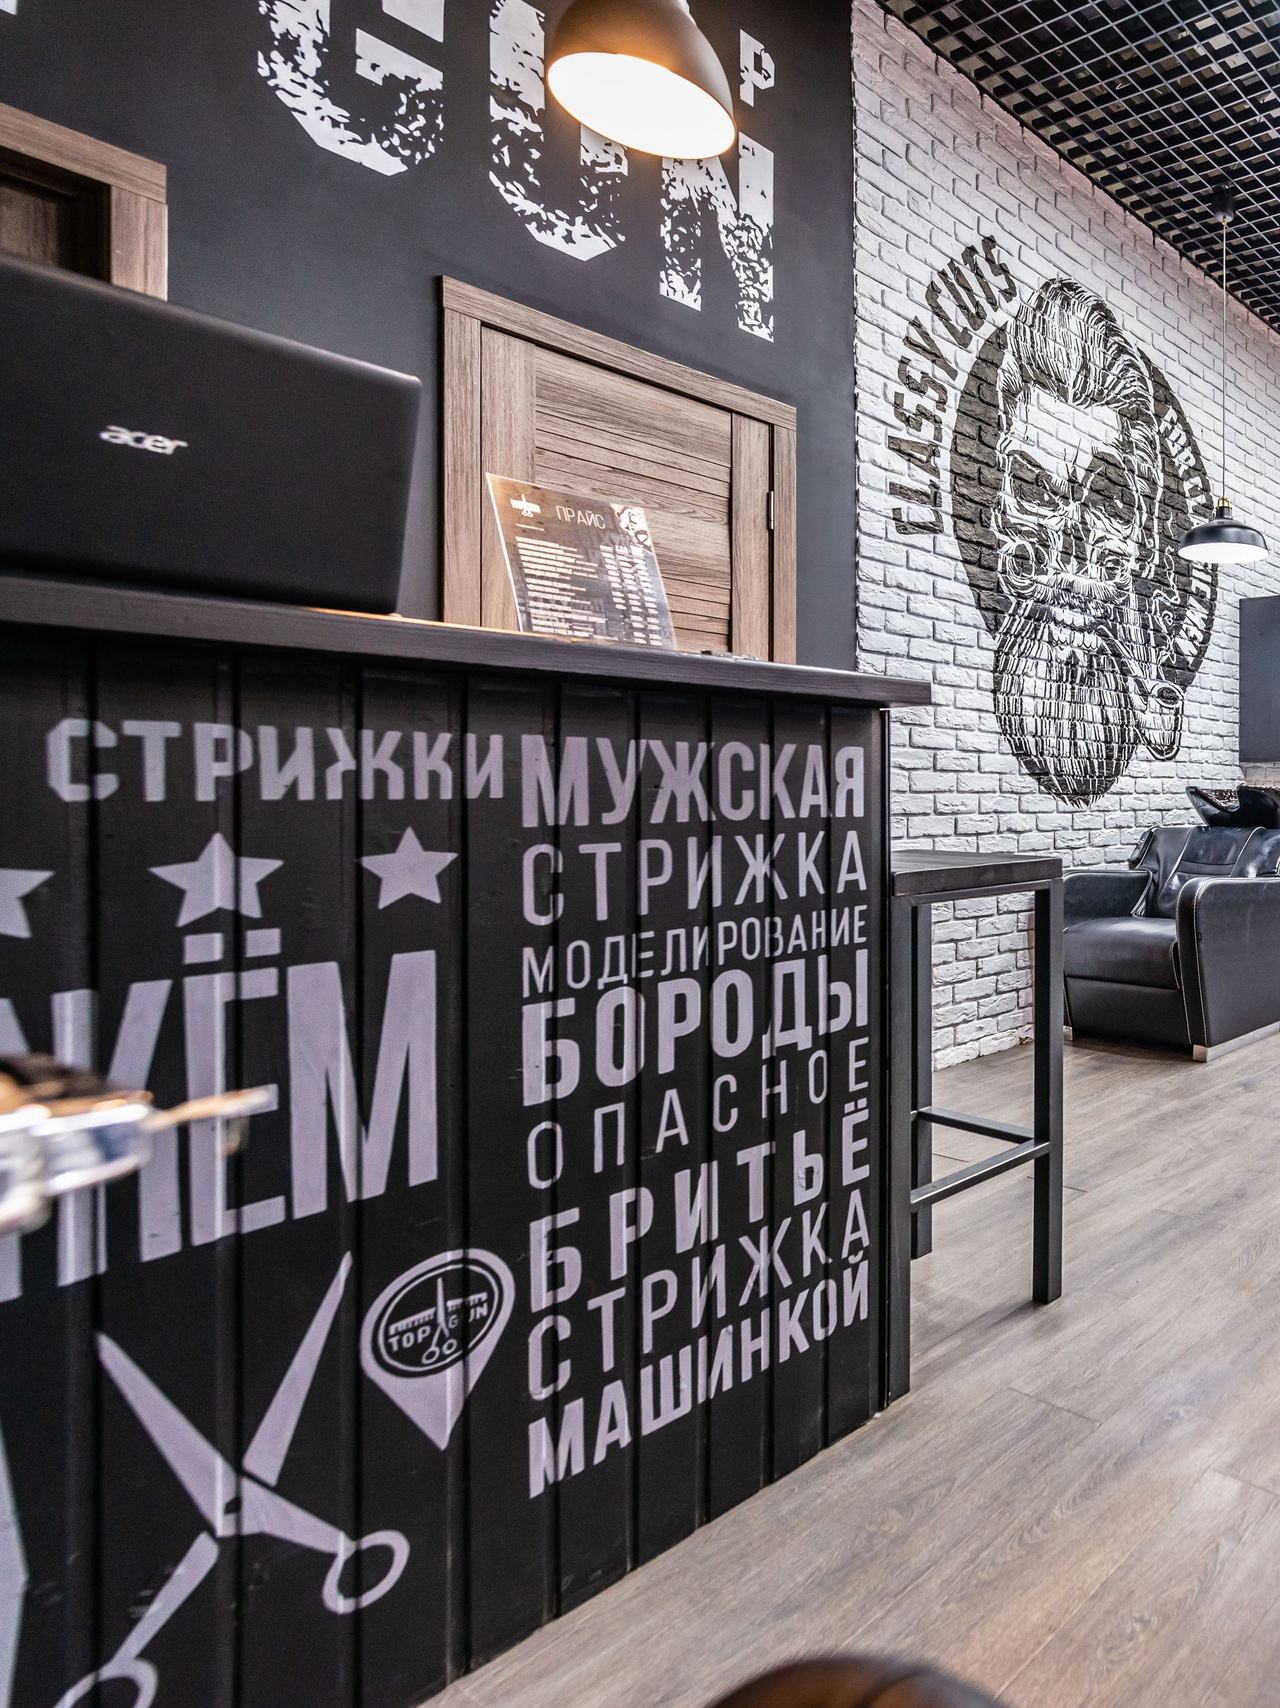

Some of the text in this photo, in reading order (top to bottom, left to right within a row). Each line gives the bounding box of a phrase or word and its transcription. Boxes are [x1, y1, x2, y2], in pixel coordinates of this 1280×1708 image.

[888, 234, 1017, 535] CLASSY CUTS
[99, 424, 188, 456] acer
[555, 505, 606, 530] ПРАЙС
[46, 717, 504, 802] СТРИЖКИ
[521, 734, 865, 828] МУЖСКАЯ
[522, 830, 867, 926] СТРИЖКА
[522, 904, 868, 998] МОДЕЛИРОВАНИЕ
[522, 949, 869, 1107] БОРОДЫ
[527, 1037, 869, 1190] ОПАСНОЕ
[529, 1098, 870, 1314] БРИТЬЁ
[388, 1325, 431, 1353] TOP
[528, 1189, 870, 1401] СТРИЖКА
[528, 1250, 869, 1500] МАШИНКОЙ
